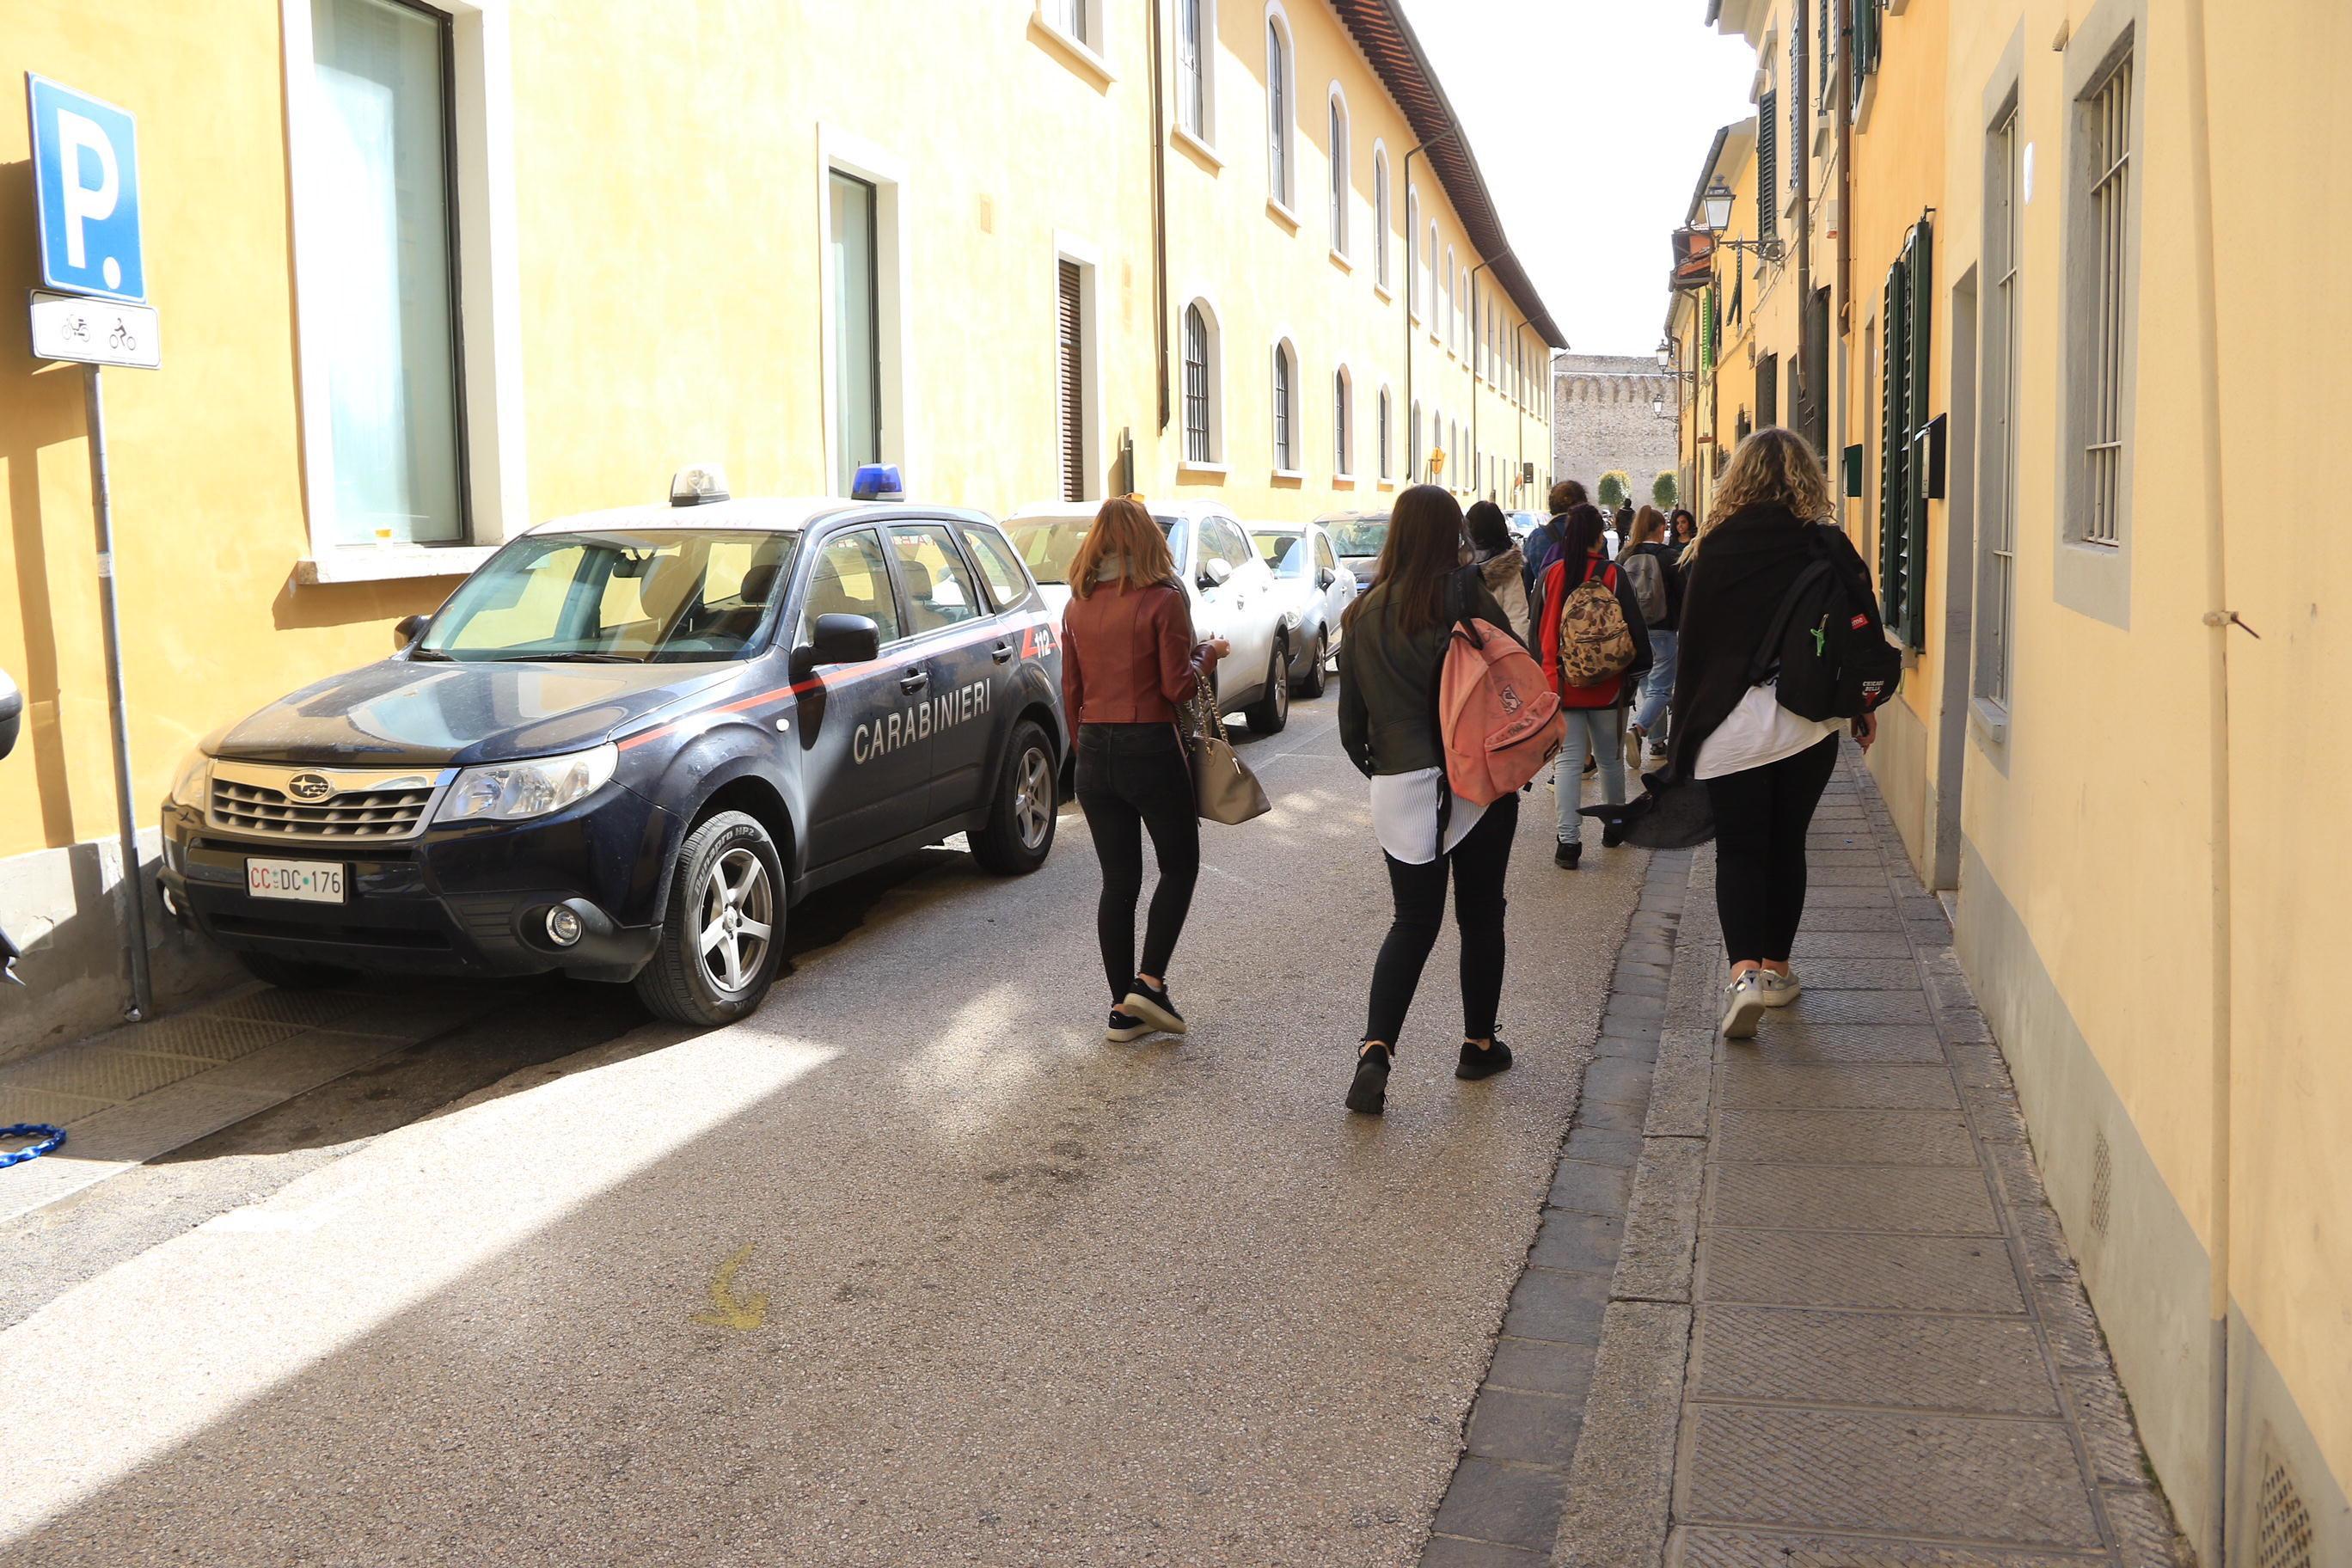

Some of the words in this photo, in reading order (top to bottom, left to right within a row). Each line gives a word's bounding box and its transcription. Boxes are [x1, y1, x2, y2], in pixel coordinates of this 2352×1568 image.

[1034, 629, 1050, 659] 112
[854, 677, 990, 764] CARABINIERI
[735, 826, 755, 836] HP2
